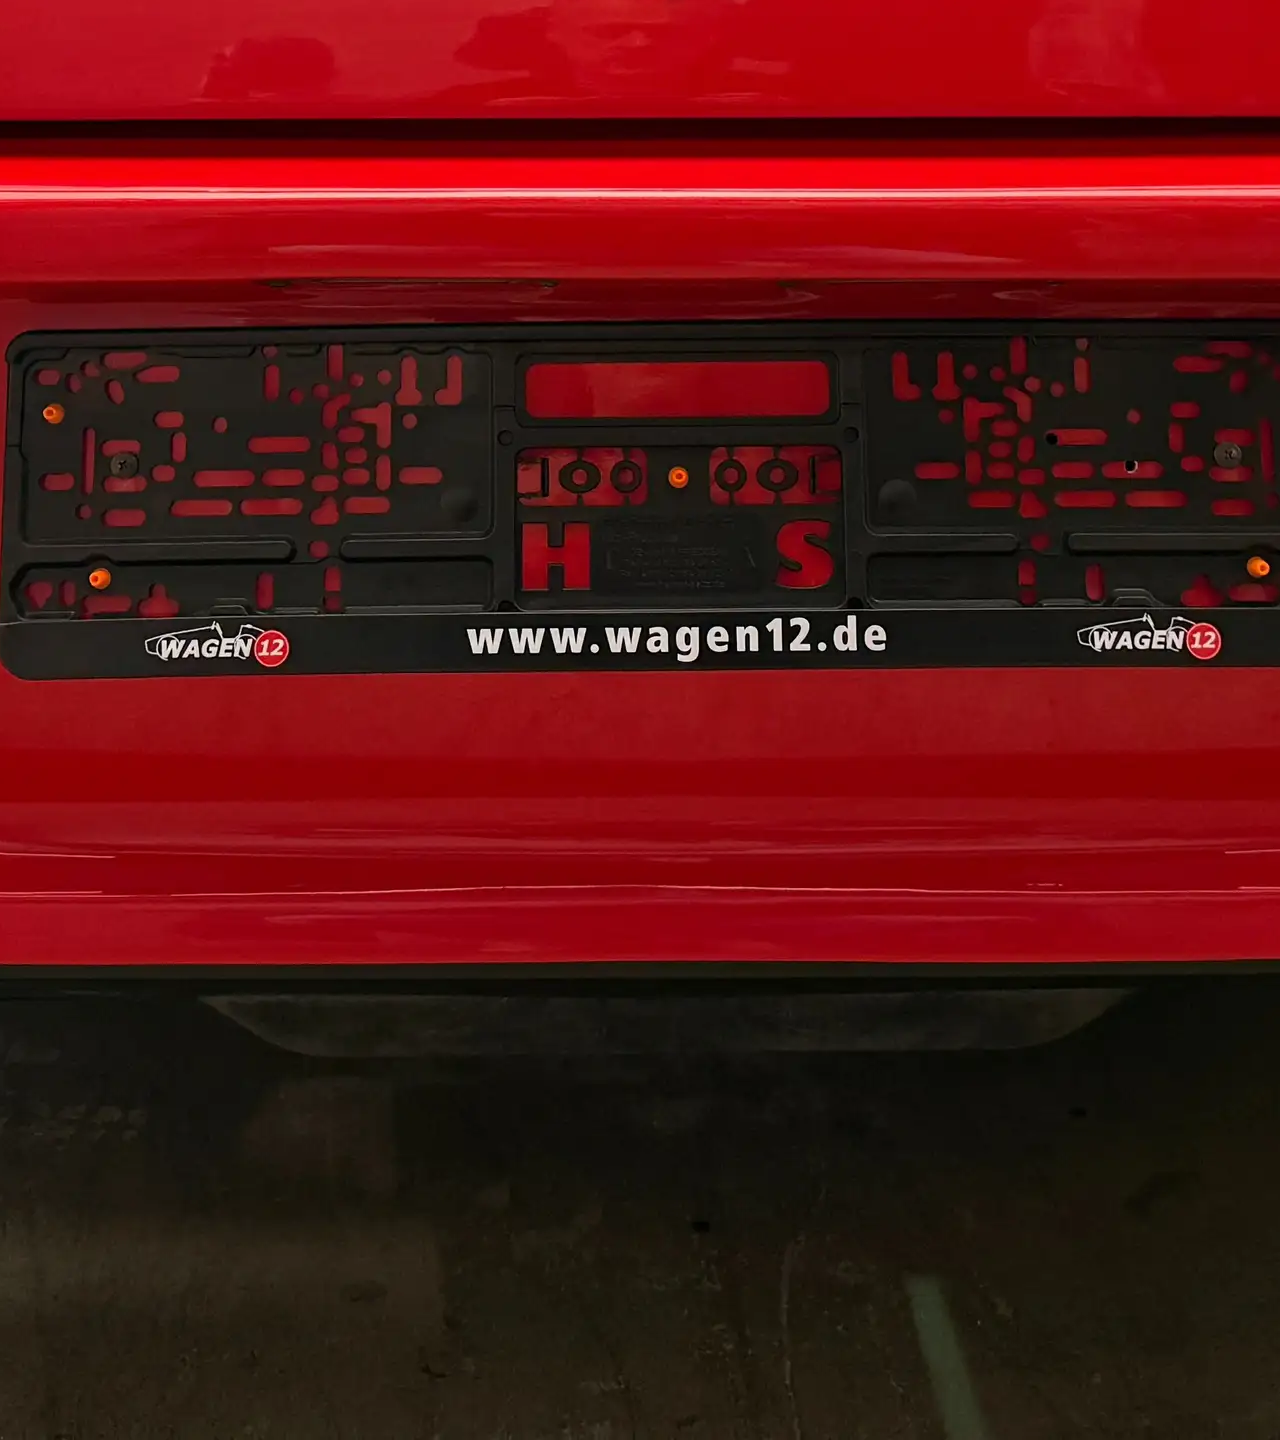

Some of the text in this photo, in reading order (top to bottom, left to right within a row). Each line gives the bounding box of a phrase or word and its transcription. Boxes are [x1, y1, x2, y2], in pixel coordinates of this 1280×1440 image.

[521, 522, 591, 591] H
[775, 520, 835, 590] S
[161, 638, 284, 659] WAGEN 12
[467, 615, 888, 662] www.wagen12.de
[1093, 630, 1216, 650] WAGEN 12
